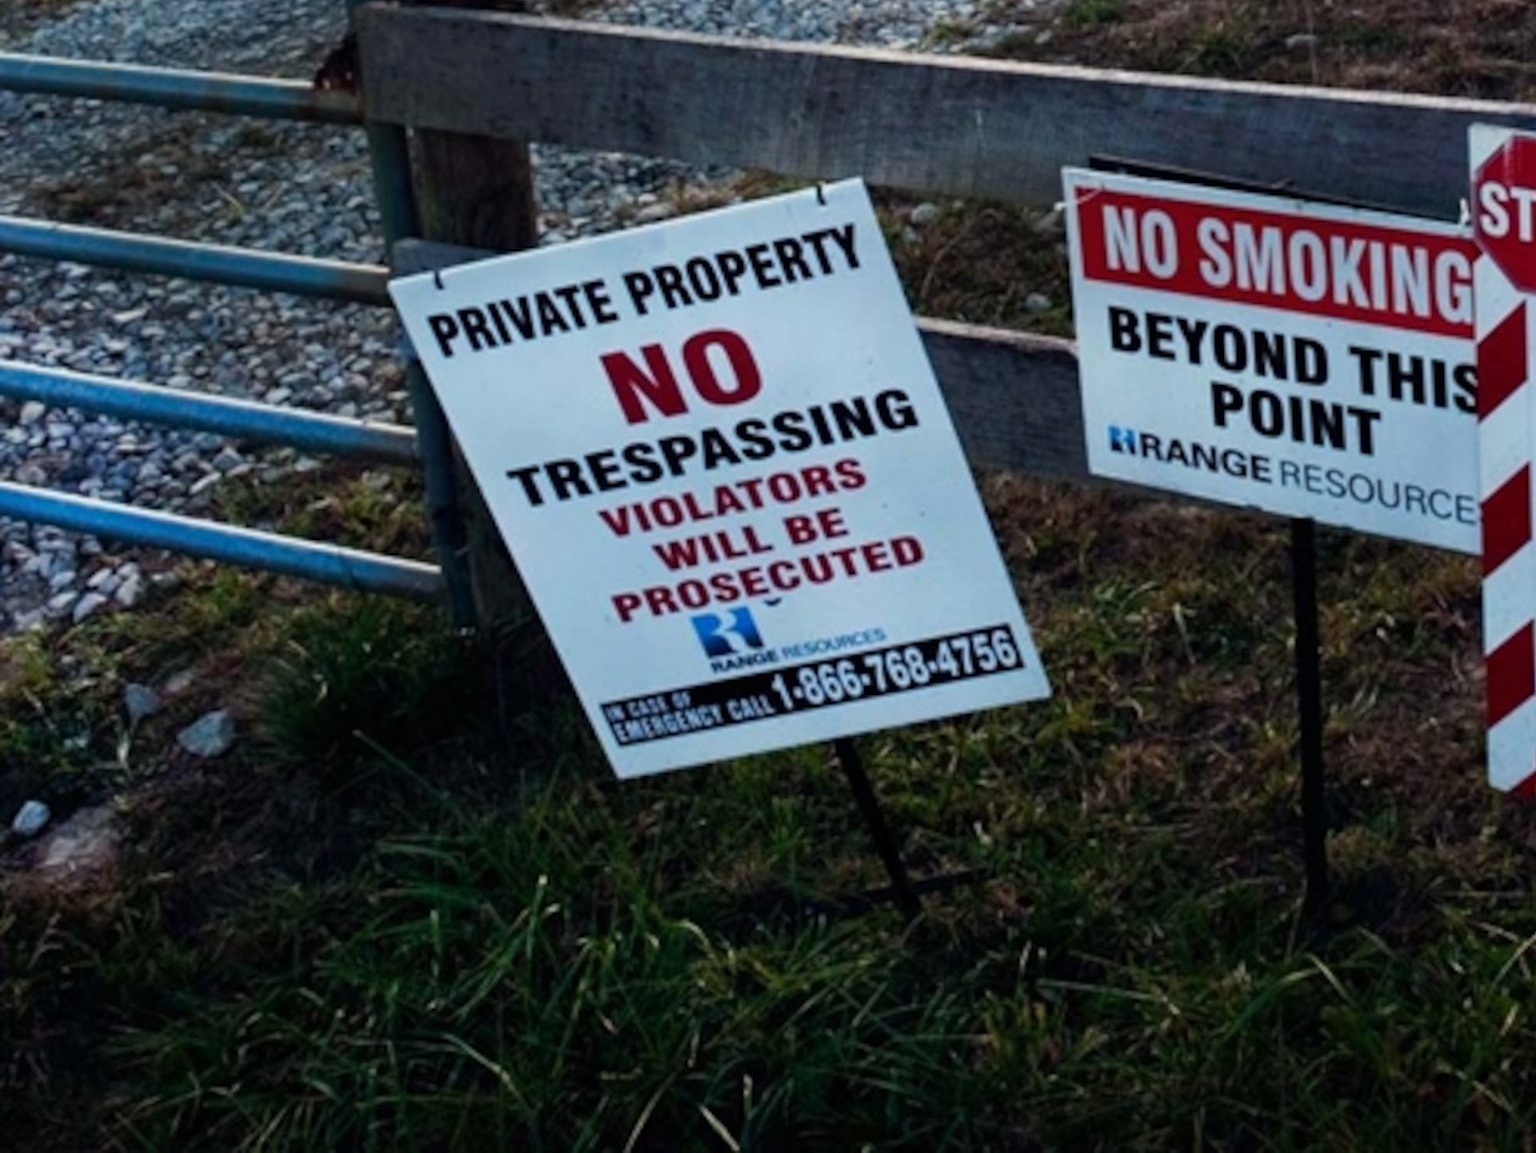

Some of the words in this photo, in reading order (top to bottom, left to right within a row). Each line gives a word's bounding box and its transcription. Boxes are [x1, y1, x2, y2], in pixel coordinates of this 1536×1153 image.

[429, 280, 617, 357] PRIVATE
[624, 224, 864, 315] PROPERTY
[1103, 204, 1179, 280] NO
[1197, 216, 1475, 325] SMOKING
[600, 328, 762, 424] NO
[1108, 306, 1329, 387] BEYOND
[1348, 345, 1478, 415] THIS
[507, 389, 919, 507] TRESPASSING
[1210, 381, 1382, 456] POINT
[598, 458, 866, 538] VIOLATORS
[1138, 432, 1273, 483] RANGE
[1281, 460, 1477, 525] RESOURCE
[612, 535, 925, 622] PROSECUTED
[653, 525, 774, 572] WILL
[784, 507, 848, 546] BE
[710, 649, 779, 674] RANGE
[781, 627, 888, 661] RESOURCES
[613, 704, 724, 743] EMERGENCY
[726, 695, 777, 720] CALL
[626, 696, 669, 719] CASE
